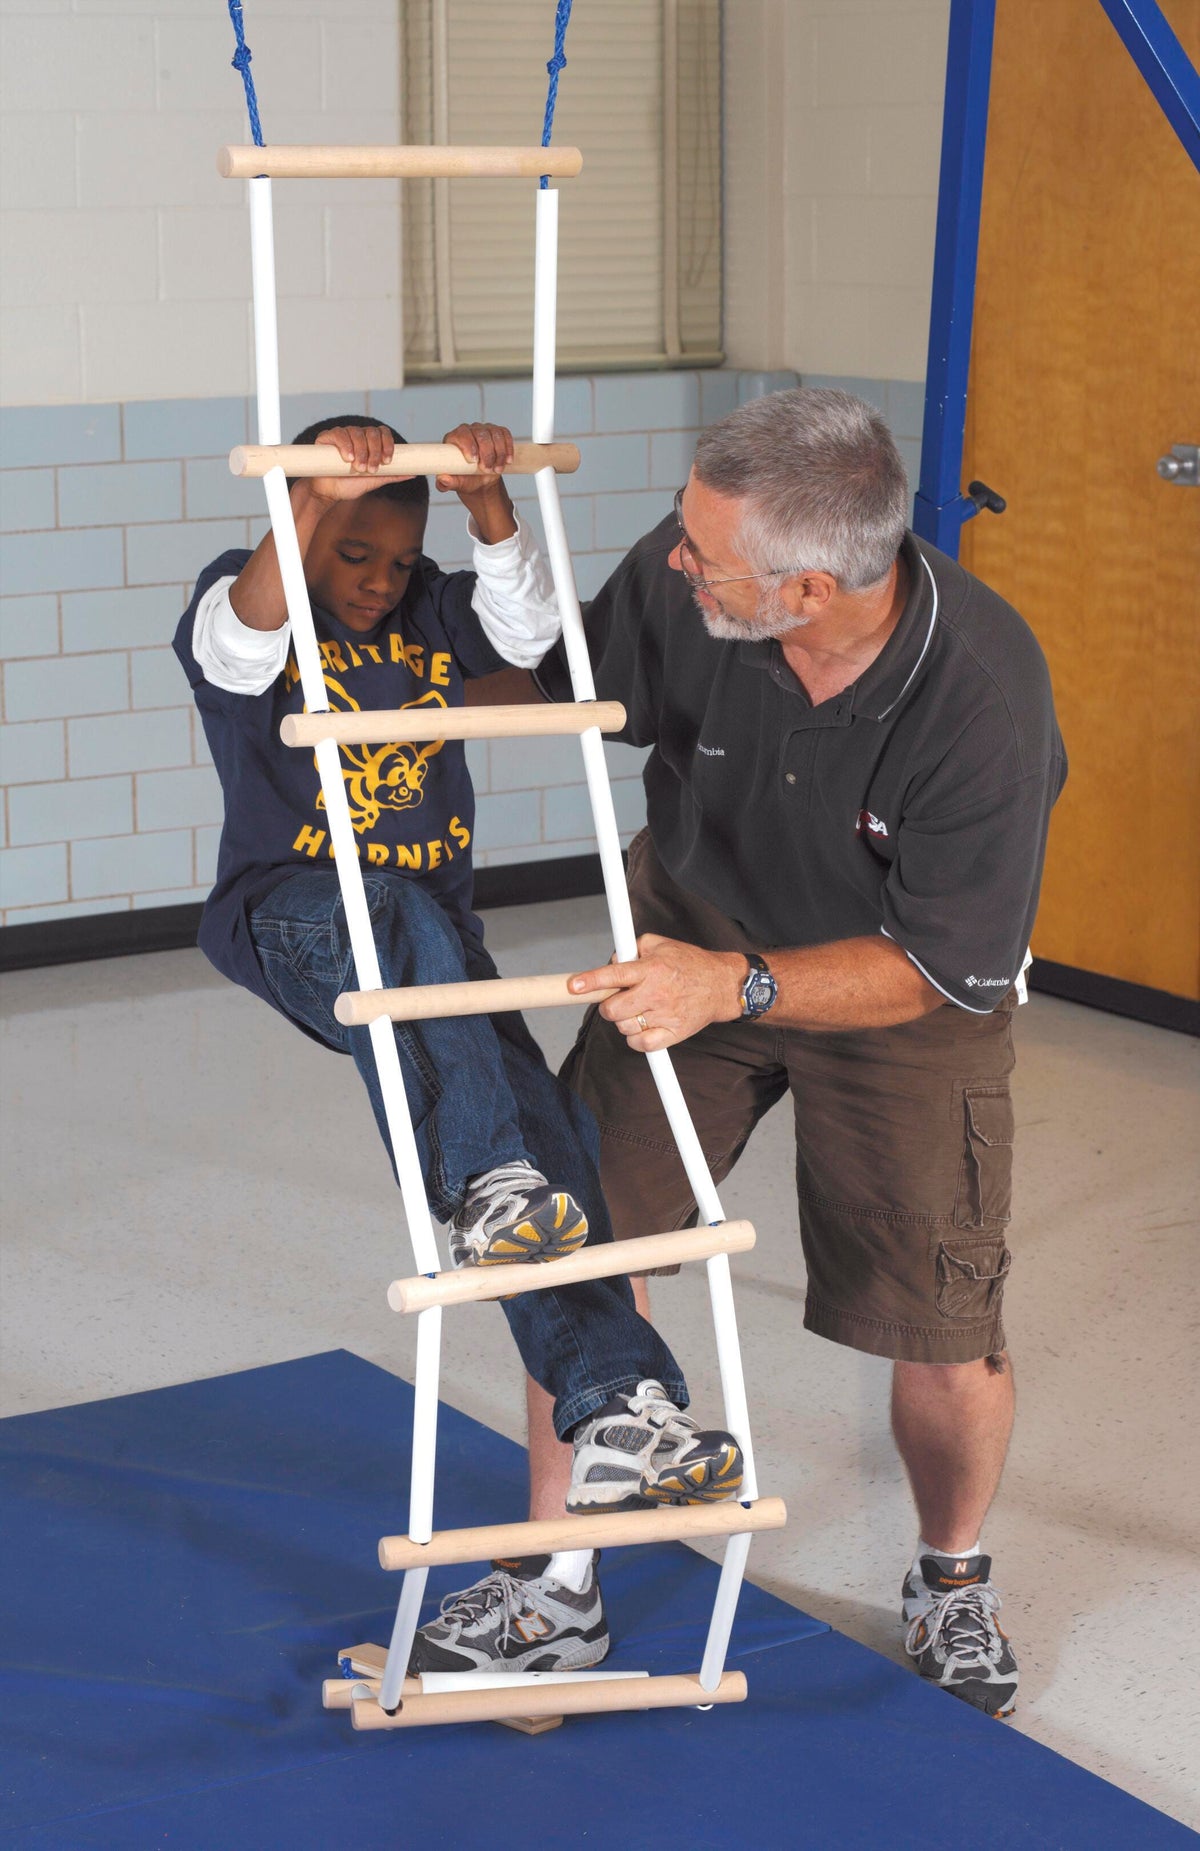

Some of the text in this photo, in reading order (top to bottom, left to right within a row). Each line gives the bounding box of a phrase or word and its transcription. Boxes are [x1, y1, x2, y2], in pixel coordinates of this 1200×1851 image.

[977, 976, 1010, 987] Columbia
[954, 1561, 967, 1574] N
[515, 1611, 549, 1643] N
